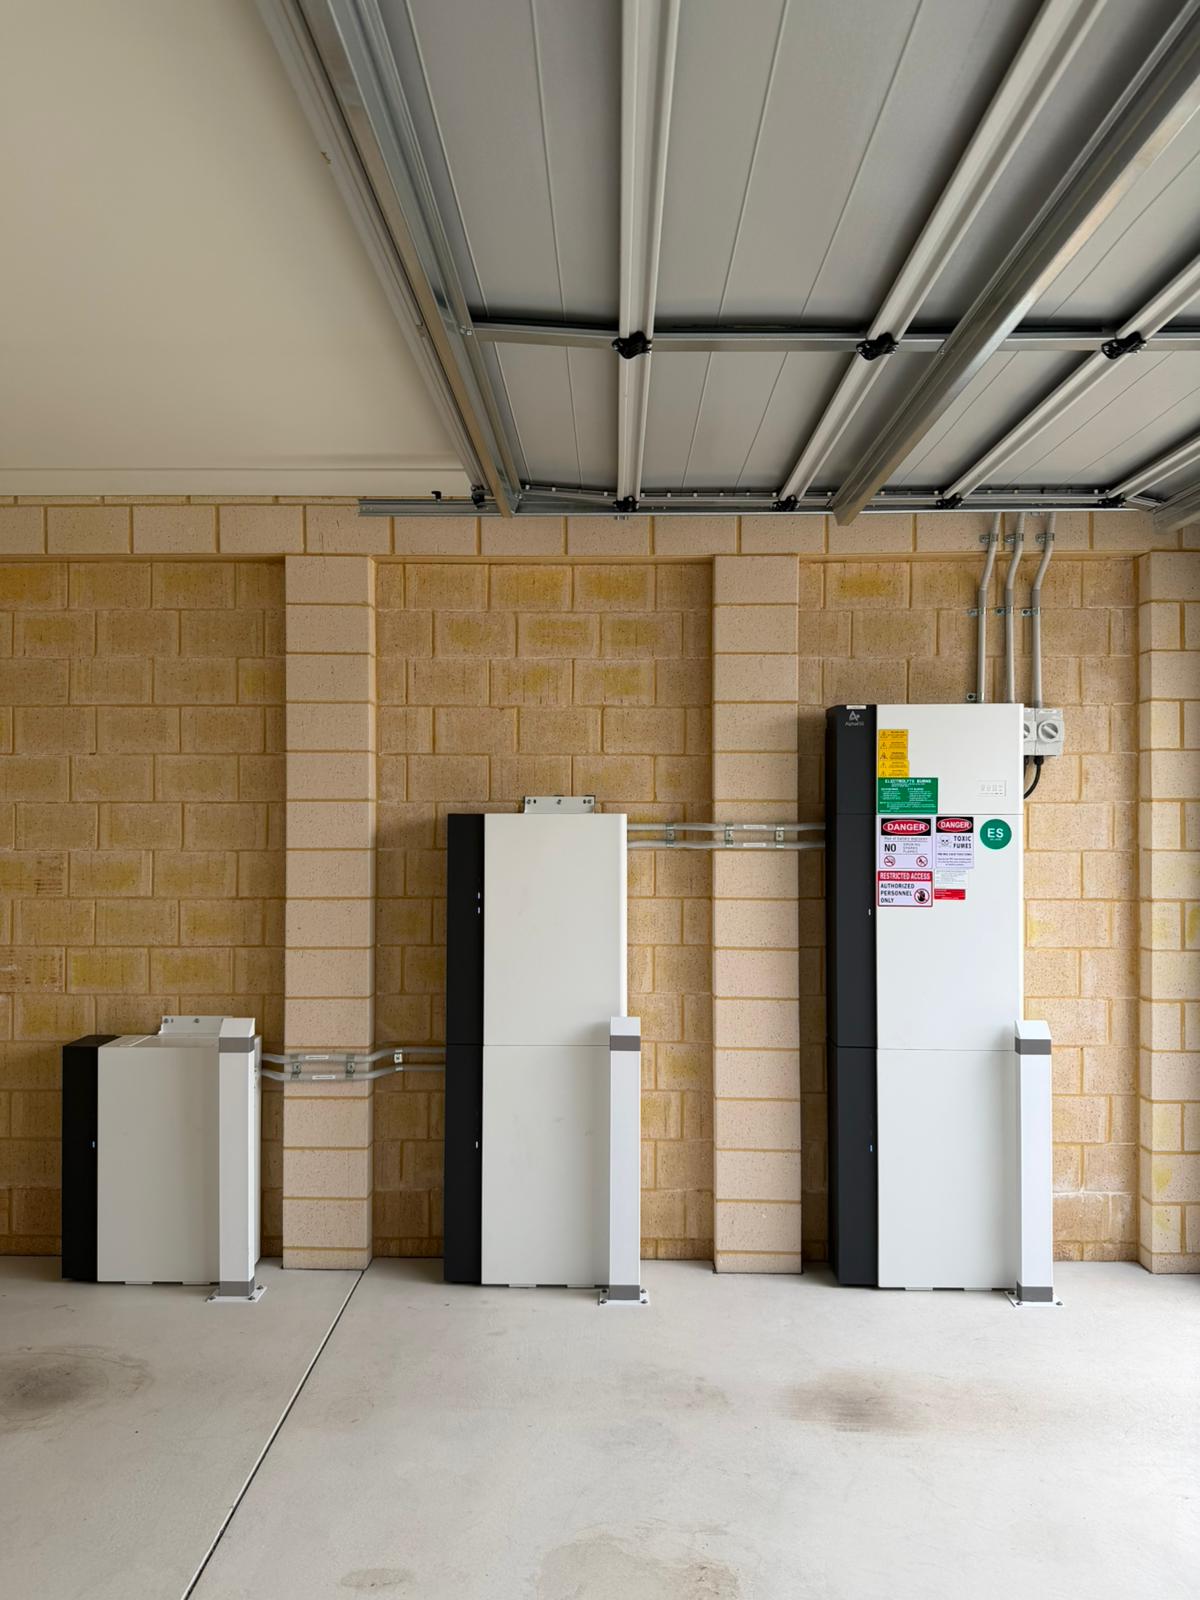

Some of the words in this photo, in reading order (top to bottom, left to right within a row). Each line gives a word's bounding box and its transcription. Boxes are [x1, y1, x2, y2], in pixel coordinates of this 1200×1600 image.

[887, 823, 926, 831] DANGER
[987, 828, 1004, 838] ES
[884, 843, 897, 852] NO
[880, 872, 911, 880] RESTRICTED
[911, 872, 931, 880] ACCESS
